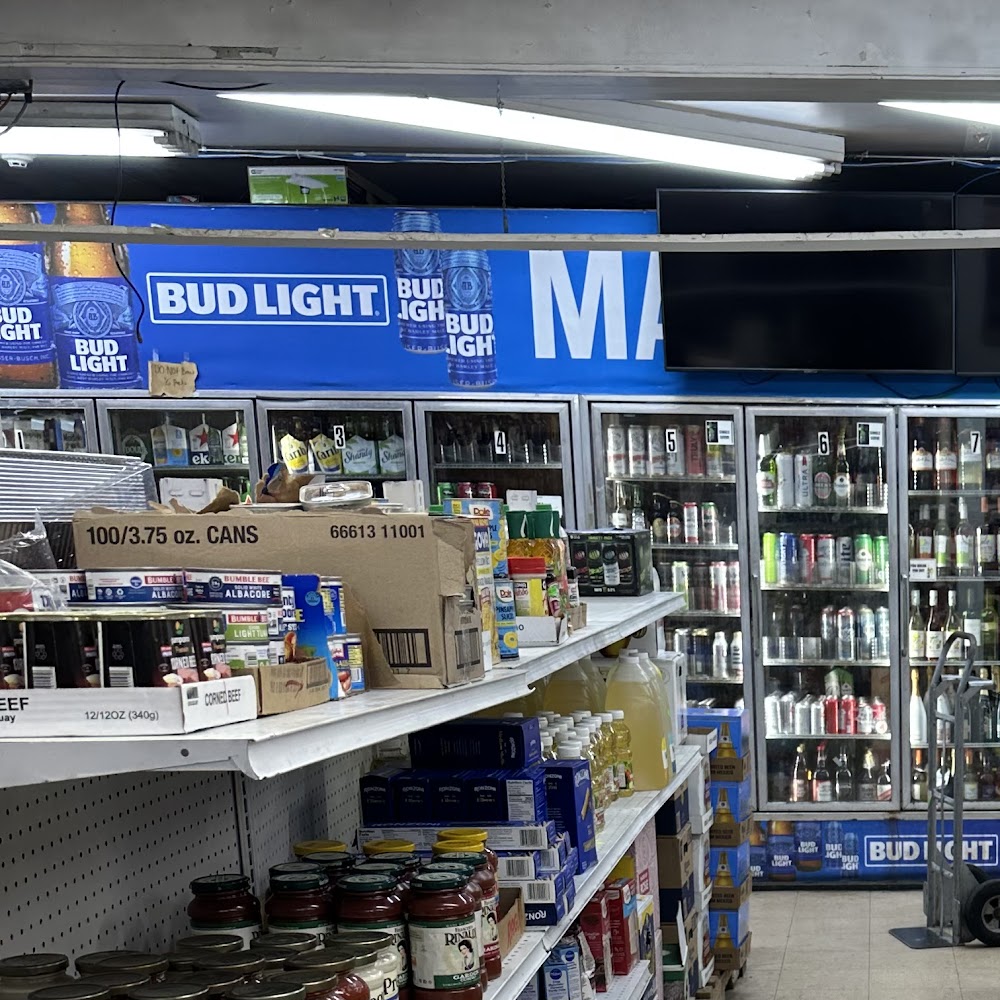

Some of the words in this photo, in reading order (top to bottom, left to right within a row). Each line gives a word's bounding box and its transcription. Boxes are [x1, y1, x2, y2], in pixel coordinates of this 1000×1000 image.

[397, 278, 444, 300] BUD
[156, 282, 248, 315] BUD
[253, 284, 379, 317] LIGHT
[446, 313, 494, 334] BUD
[75, 338, 119, 356] BUD
[69, 354, 129, 373] LIGHT
[334, 427, 345, 448] 3
[496, 431, 505, 454] 4
[666, 430, 676, 452] 5
[819, 433, 828, 454] 6
[972, 433, 980, 453] 7
[473, 507, 491, 516] Dole
[87, 525, 168, 546] 100/3.75
[174, 528, 200, 545] oz.
[207, 525, 259, 544] CANS
[331, 524, 376, 540] 66613
[381, 524, 425, 539] 11001
[224, 575, 255, 583] BUMBLE
[225, 589, 271, 599] ALBACORE
[204, 690, 226, 706] CORNED
[227, 688, 241, 702] BEEF
[128, 710, 160, 722] (340g)
[870, 841, 919, 861] BUD
